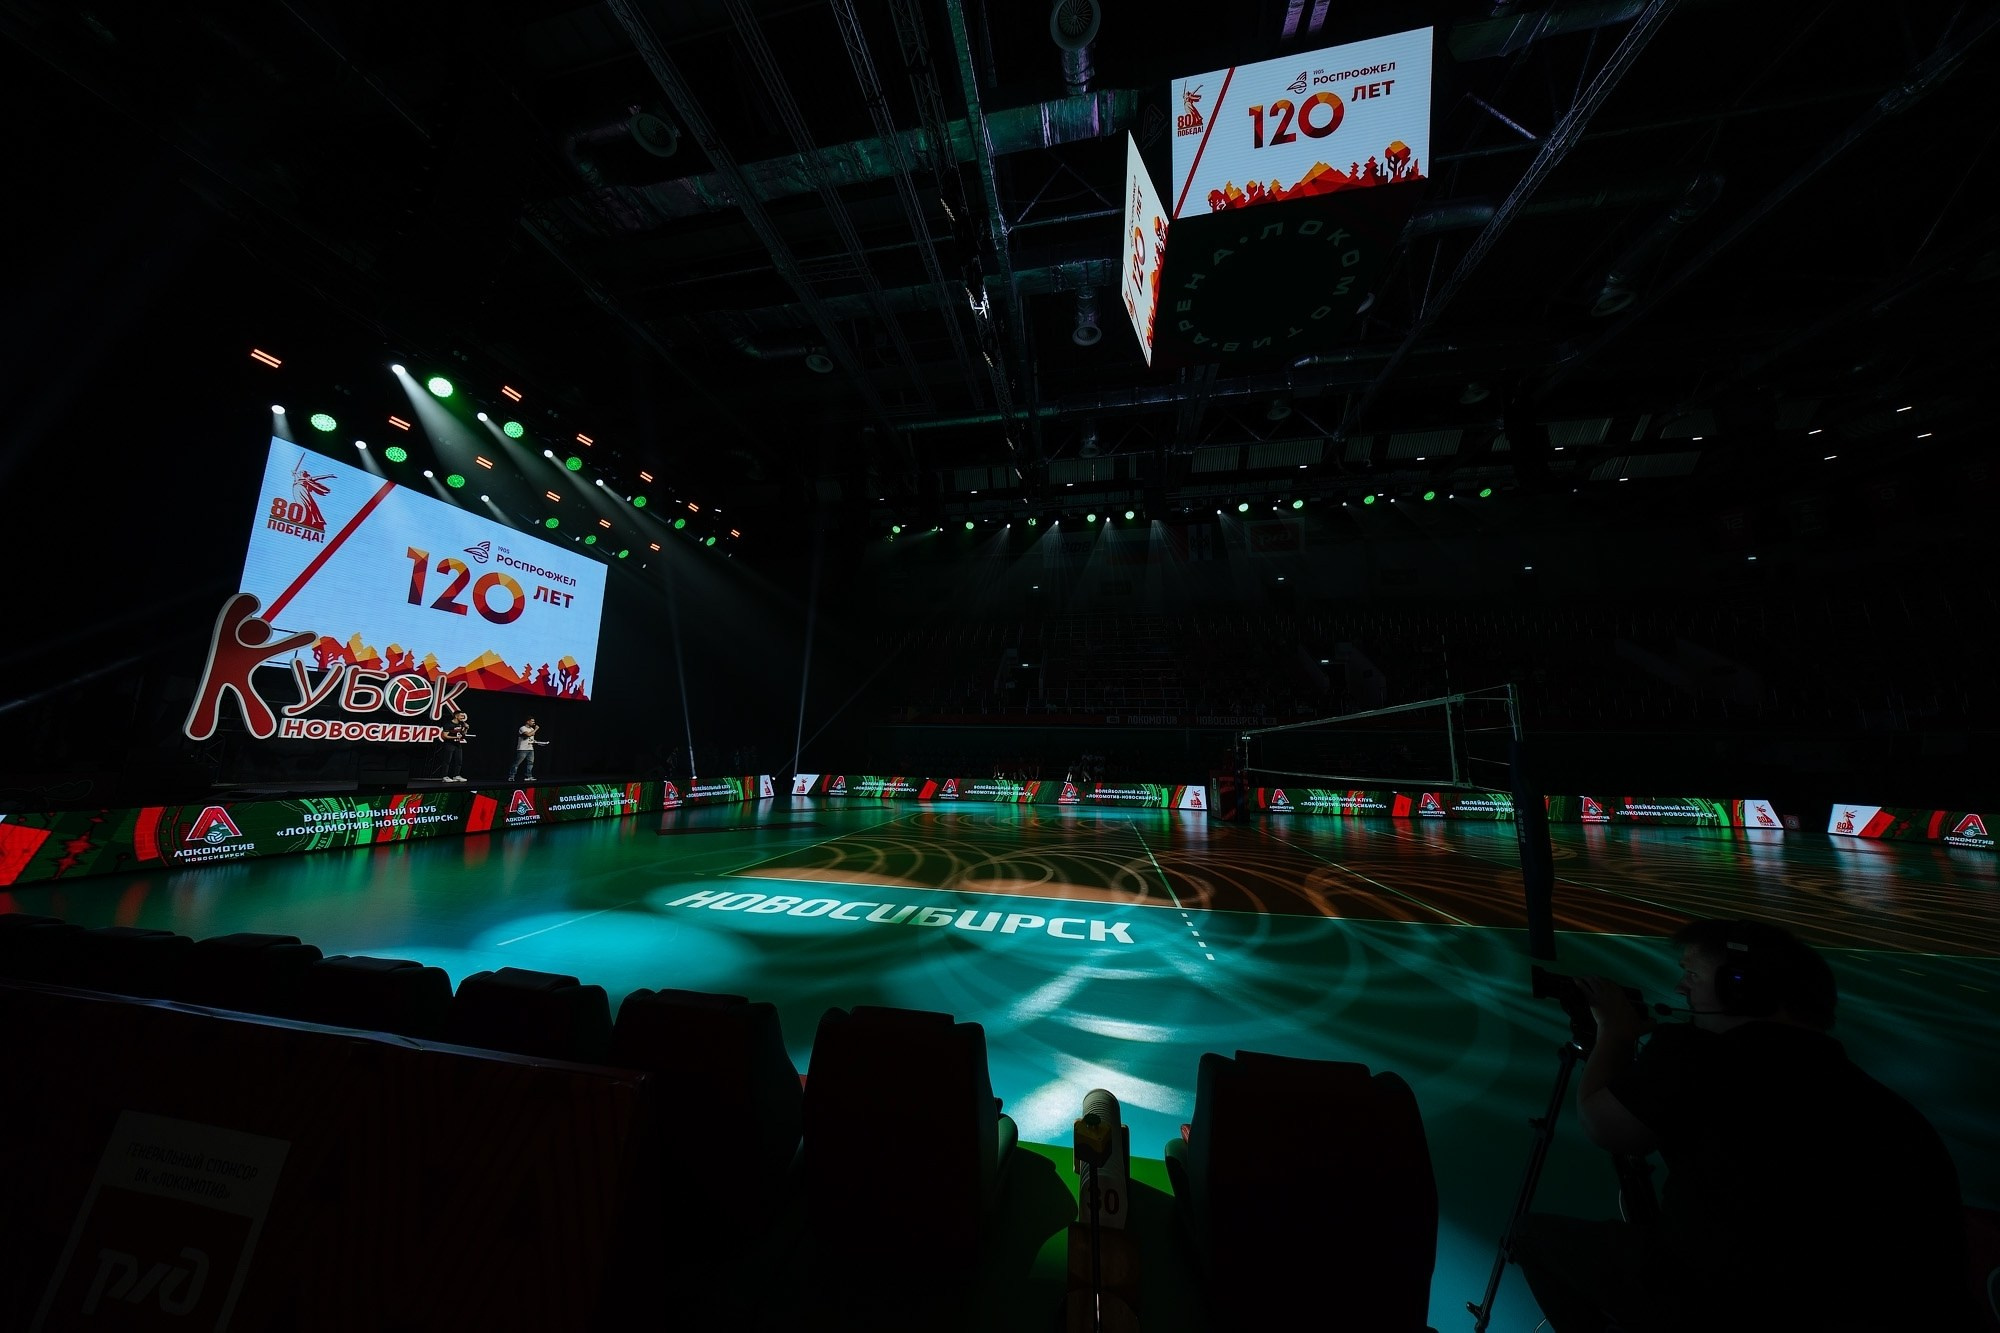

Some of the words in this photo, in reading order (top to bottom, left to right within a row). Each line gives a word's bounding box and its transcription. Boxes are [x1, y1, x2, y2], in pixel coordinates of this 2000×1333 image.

[1313, 62, 1396, 86] РОСПРОФЖЕЛ
[1177, 113, 1192, 128] 80
[1248, 91, 1345, 149] 120
[1351, 80, 1395, 102] ЛЕТ
[1177, 126, 1204, 137] ПОБЕДА!
[271, 497, 304, 523] 80
[267, 519, 325, 543] ПОБЕДА!
[496, 553, 576, 588] РОСПРОФЖЕЛ
[406, 546, 525, 625] 120
[533, 585, 574, 608] ЛЕТ
[280, 717, 466, 743] НОВОСИБИР
[276, 814, 459, 837] «ЛОКОМОТИВ-НОВОСИБИРСК»
[303, 806, 406, 823] ВОЛЕЙБОЛЬНЫЙ
[409, 805, 437, 815] КЛУБ
[173, 843, 255, 858] ЛОКОМОТИВ
[1943, 836, 1995, 846] ЛОКОМОТИВ
[664, 889, 1135, 944] НОВОСИБИРСК
[127, 1142, 204, 1170] ГЕНЕРАЛЬНЫЙ
[206, 1157, 258, 1182] СПОНСОР
